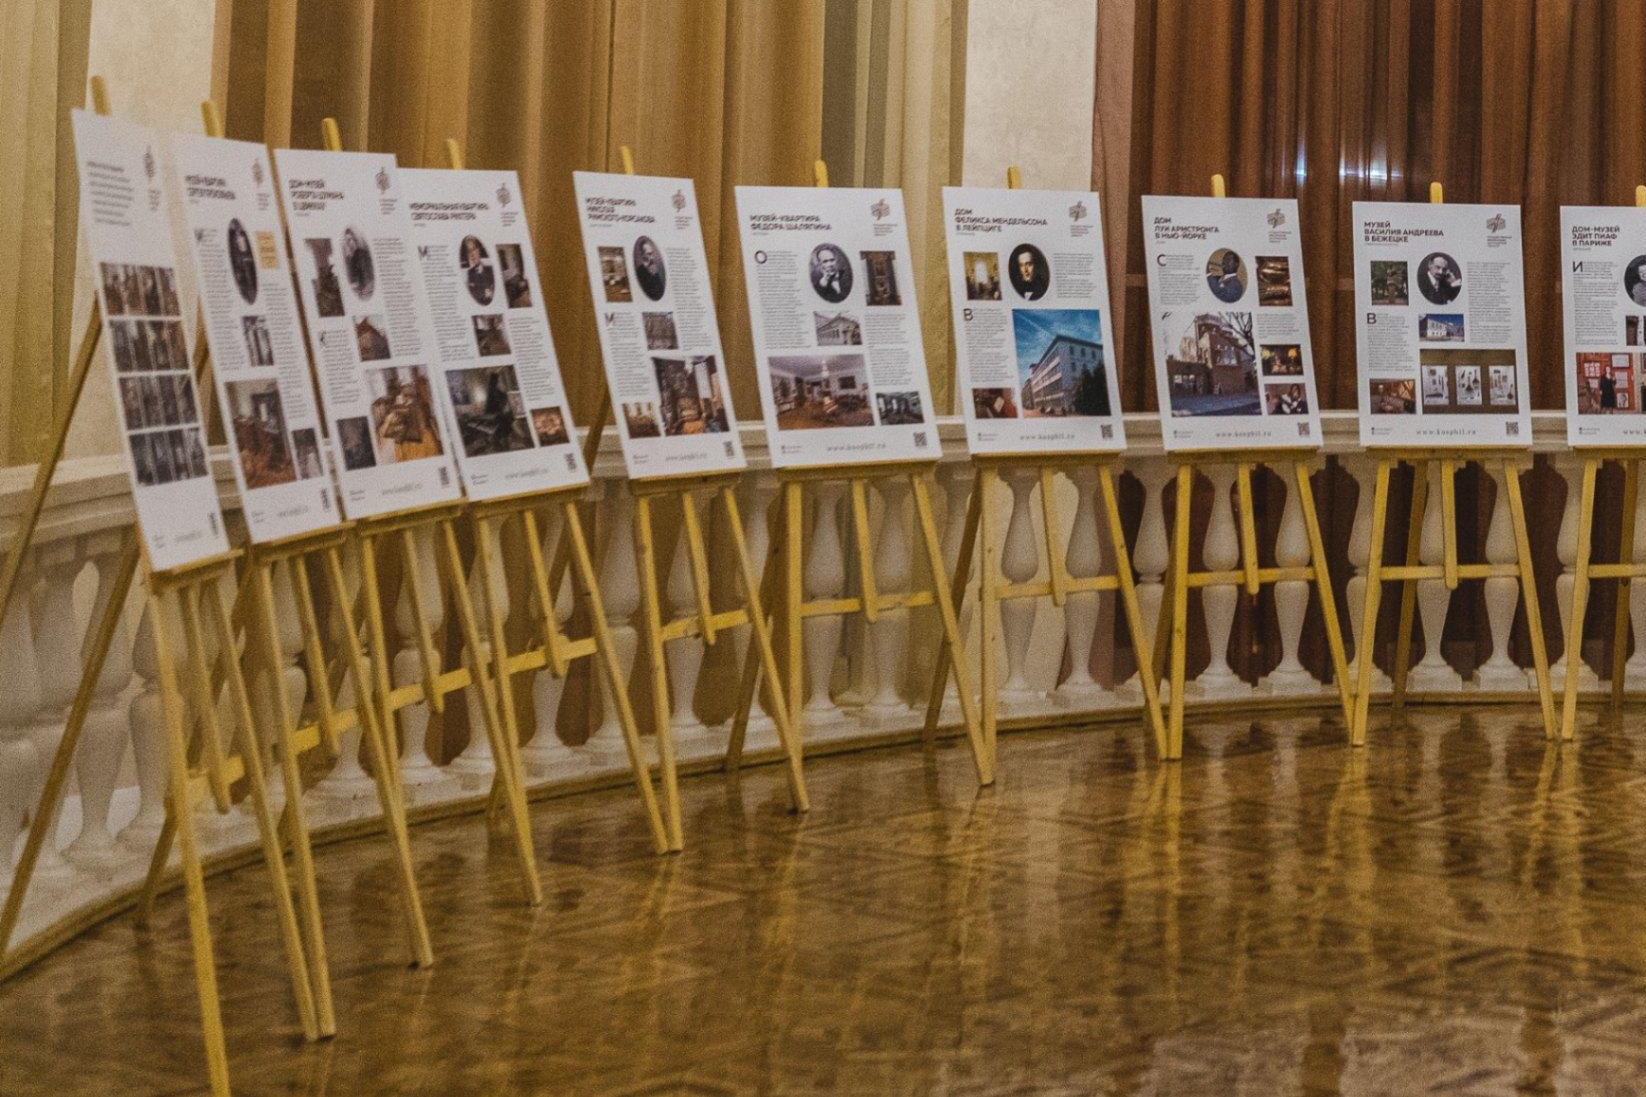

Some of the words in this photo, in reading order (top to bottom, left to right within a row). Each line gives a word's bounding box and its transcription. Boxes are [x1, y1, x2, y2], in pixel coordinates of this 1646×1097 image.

[1364, 220, 1391, 228] МУЗЕЙ
[1403, 229, 1444, 237] АНДРЕЕВА
[1572, 225, 1620, 233] ДОМ-МУЗЕЙ
